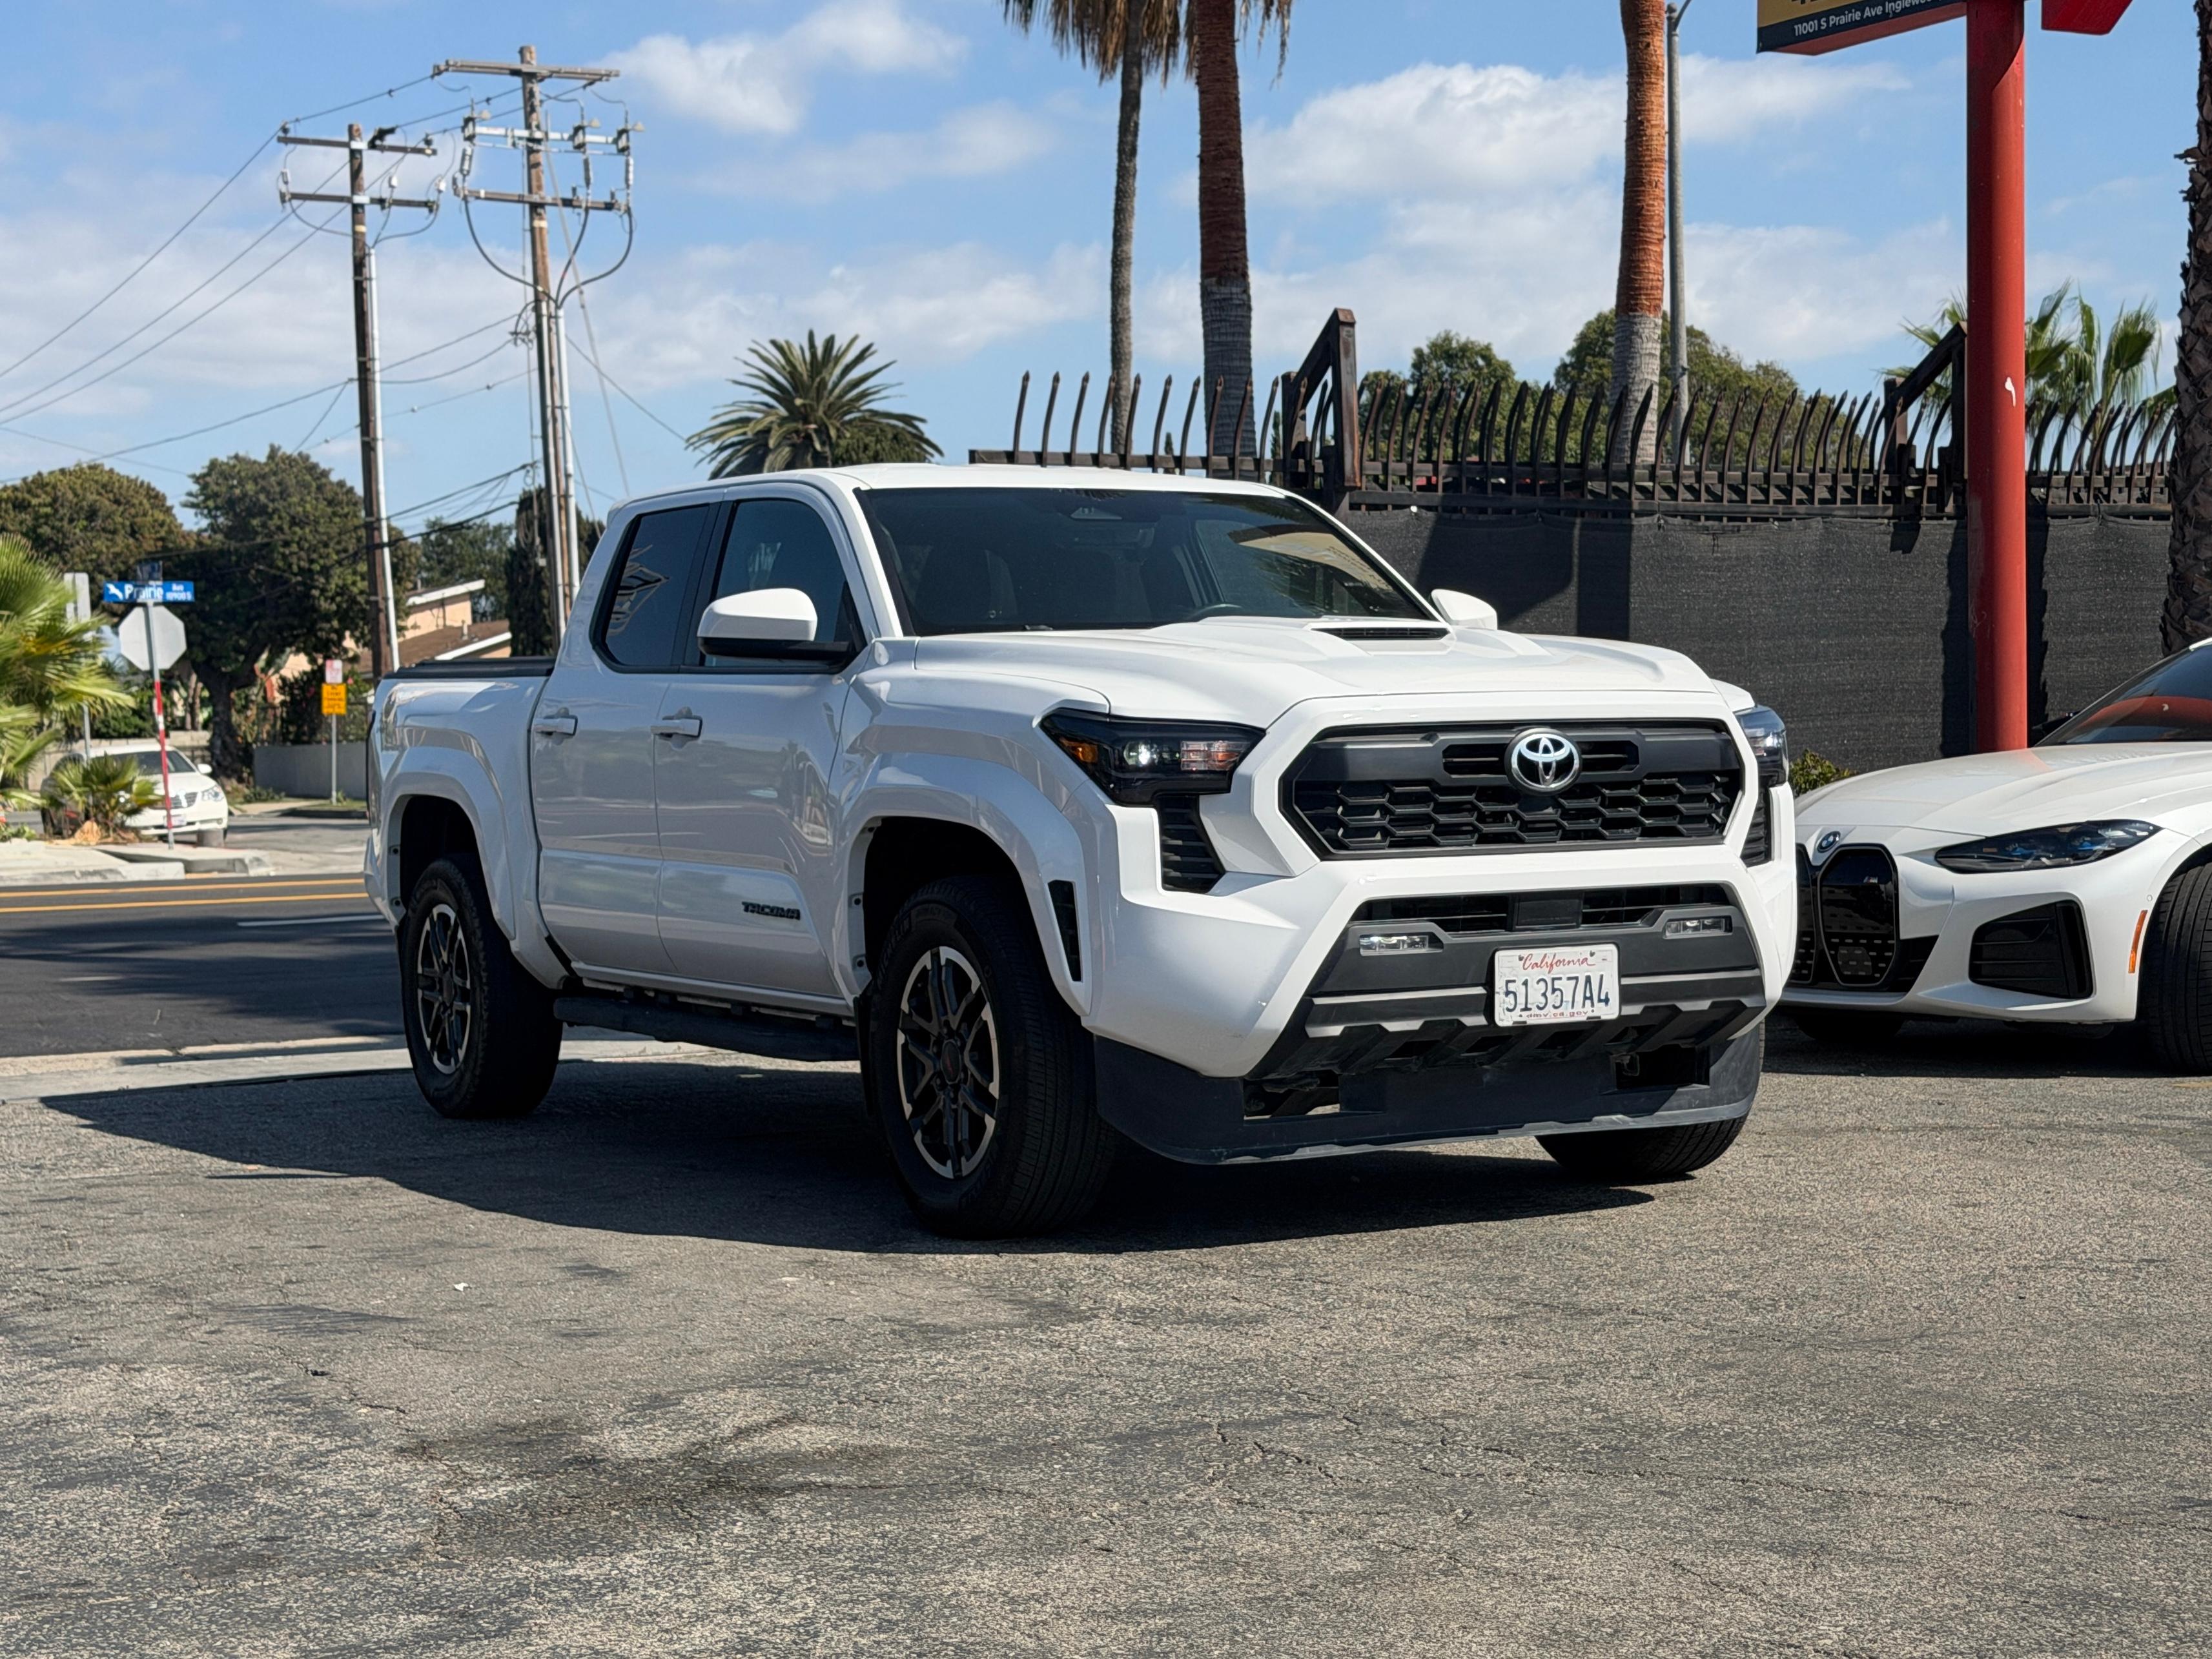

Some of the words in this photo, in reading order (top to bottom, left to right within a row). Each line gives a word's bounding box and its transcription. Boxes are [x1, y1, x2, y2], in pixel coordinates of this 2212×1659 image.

[1794, 21, 1818, 37] 11001
[1820, 17, 1827, 30] S
[1829, 8, 1861, 28] Prairie
[1863, 5, 1883, 19] Ave
[125, 584, 163, 600] Prairie
[742, 901, 801, 921] TACOMA
[1522, 953, 1596, 974] California
[1504, 973, 1610, 1013] 51357A4
